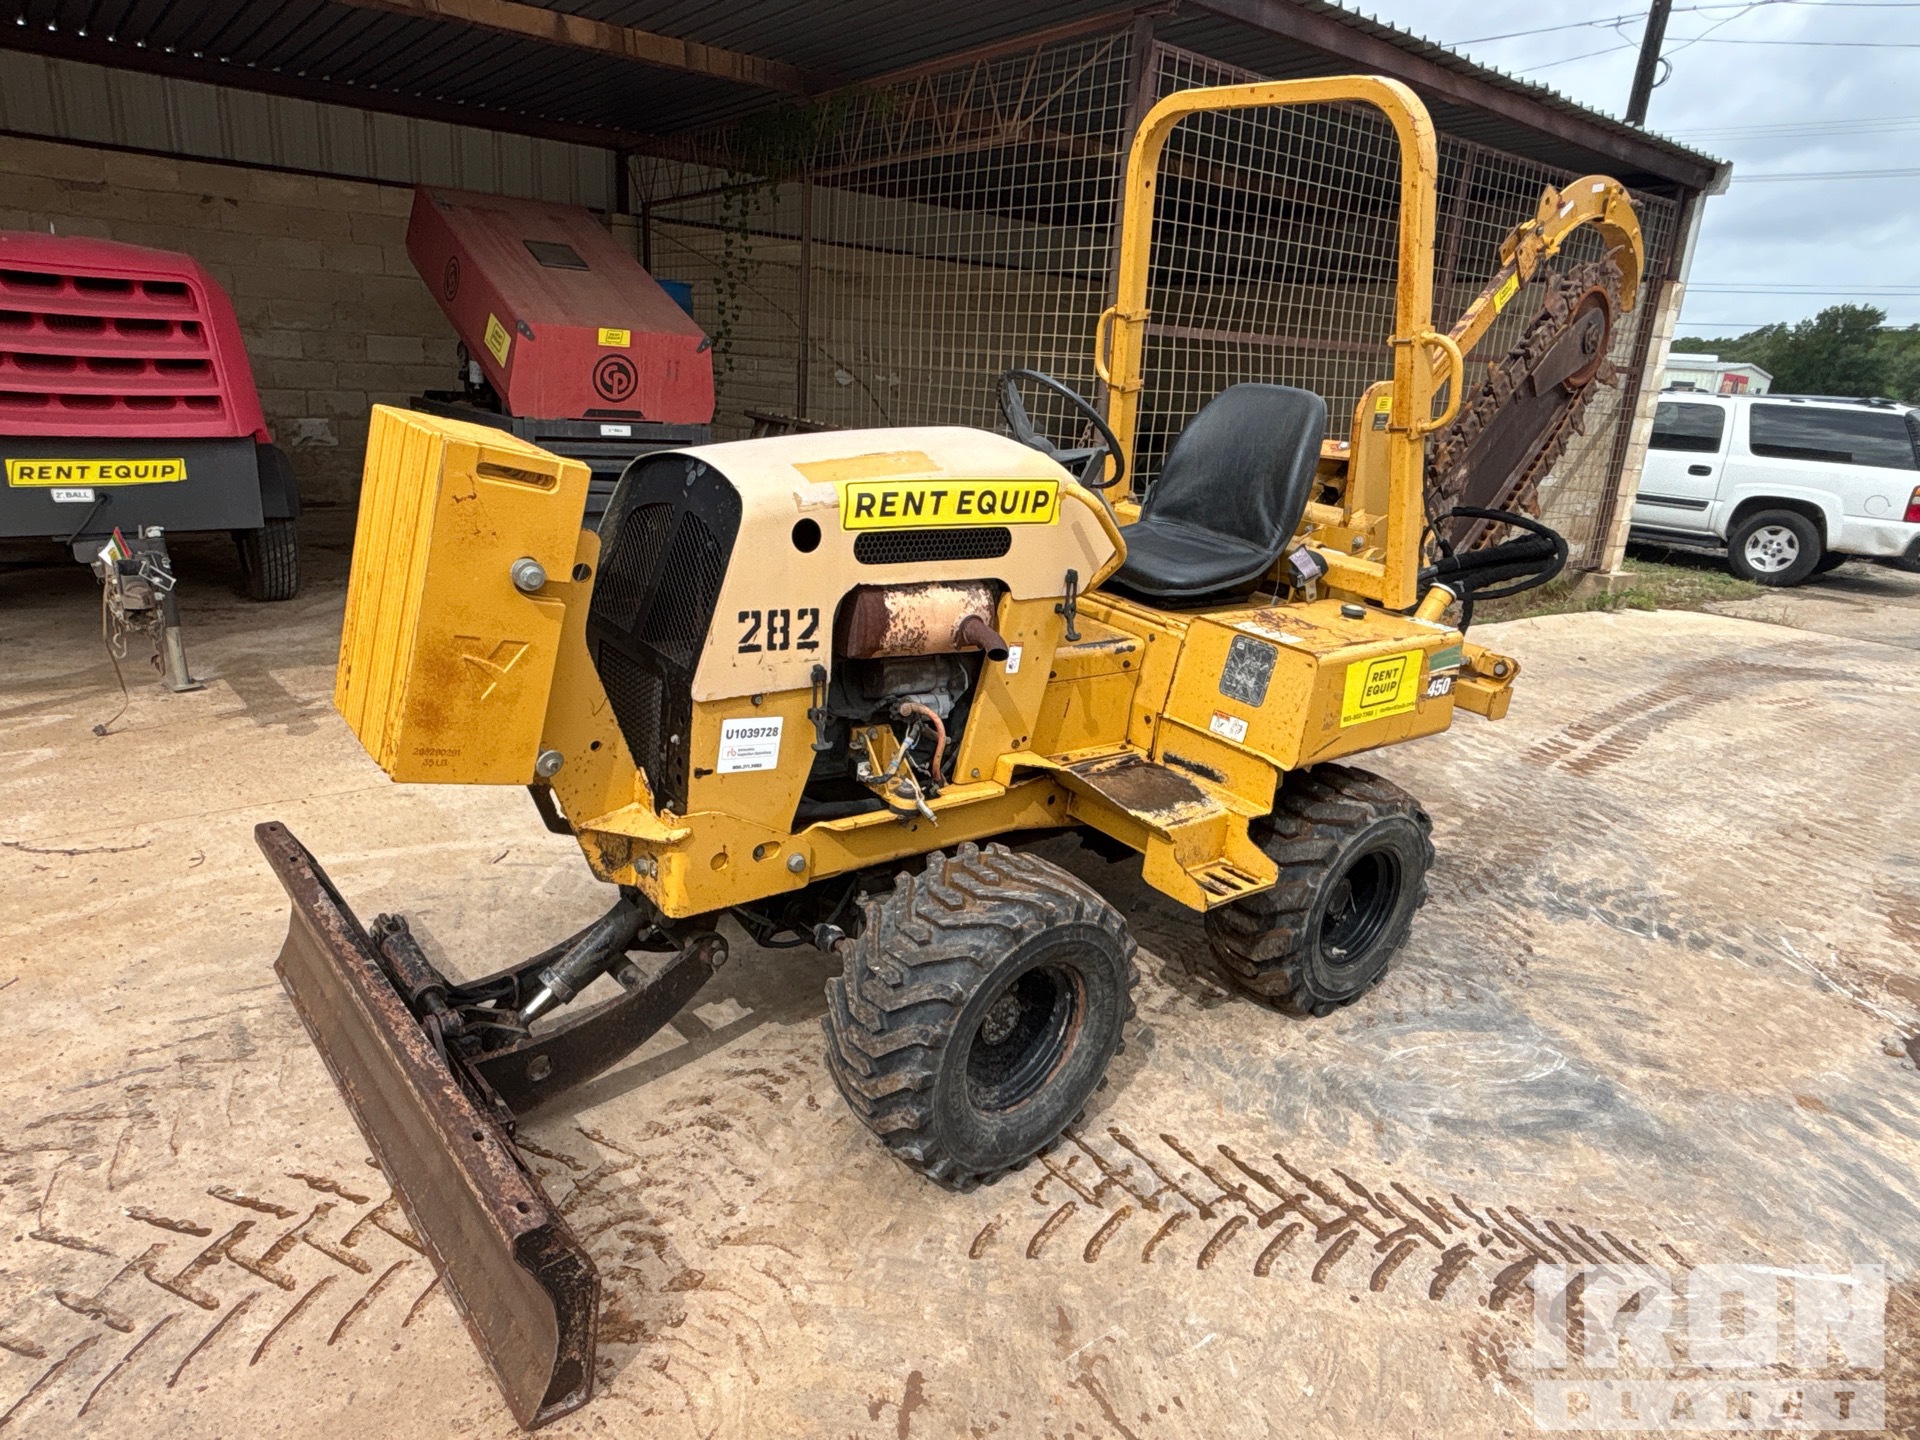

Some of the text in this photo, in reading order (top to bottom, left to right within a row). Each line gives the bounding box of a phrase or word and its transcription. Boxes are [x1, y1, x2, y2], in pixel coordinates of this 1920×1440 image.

[18, 464, 175, 480] RENT EQUIP
[65, 491, 90, 499] BALL
[854, 489, 1050, 518] RENT EQUIP
[738, 608, 820, 653] 282
[1371, 667, 1400, 683] RENT
[1365, 681, 1397, 698] EQUIP
[1427, 677, 1452, 697] 450
[725, 726, 779, 740] U1039728
